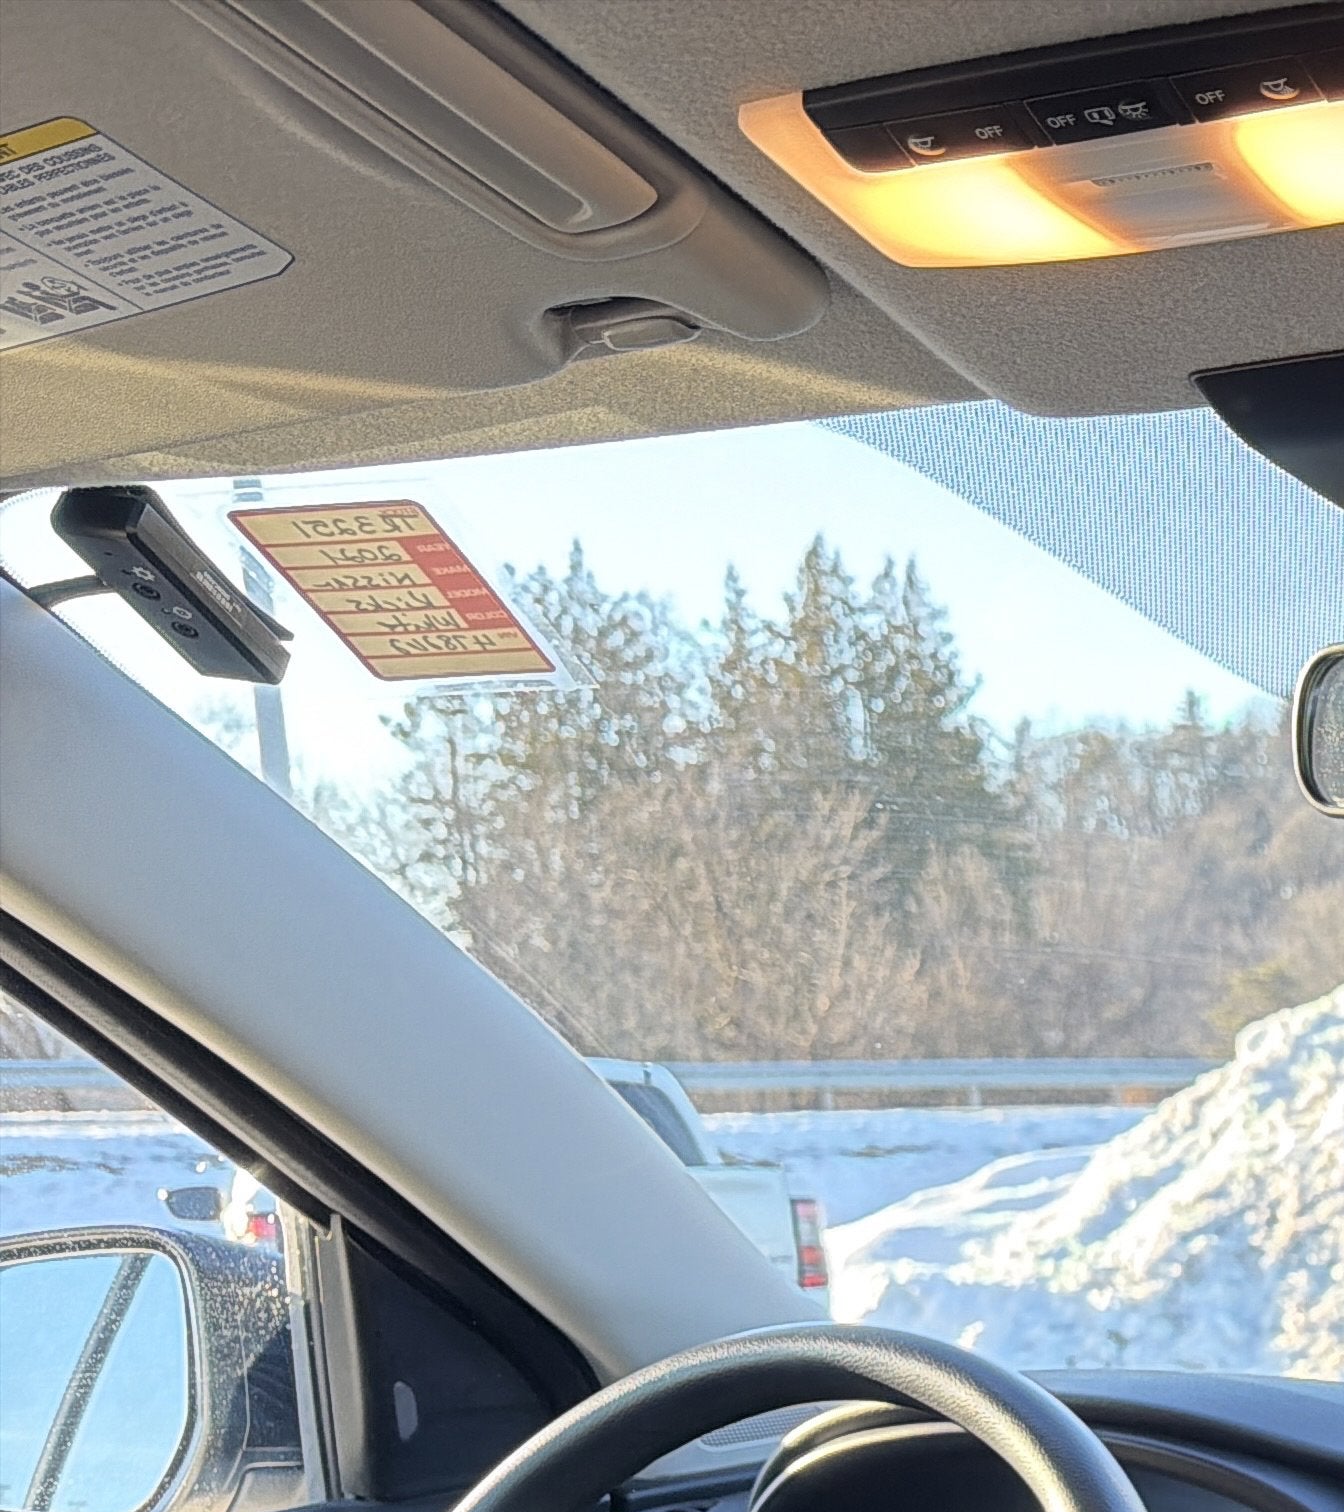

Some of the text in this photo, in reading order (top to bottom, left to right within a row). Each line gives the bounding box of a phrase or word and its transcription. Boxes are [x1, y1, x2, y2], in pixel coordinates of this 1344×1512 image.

[1195, 90, 1226, 105] OFF
[1047, 114, 1076, 129] OFF
[974, 124, 1003, 140] OFF
